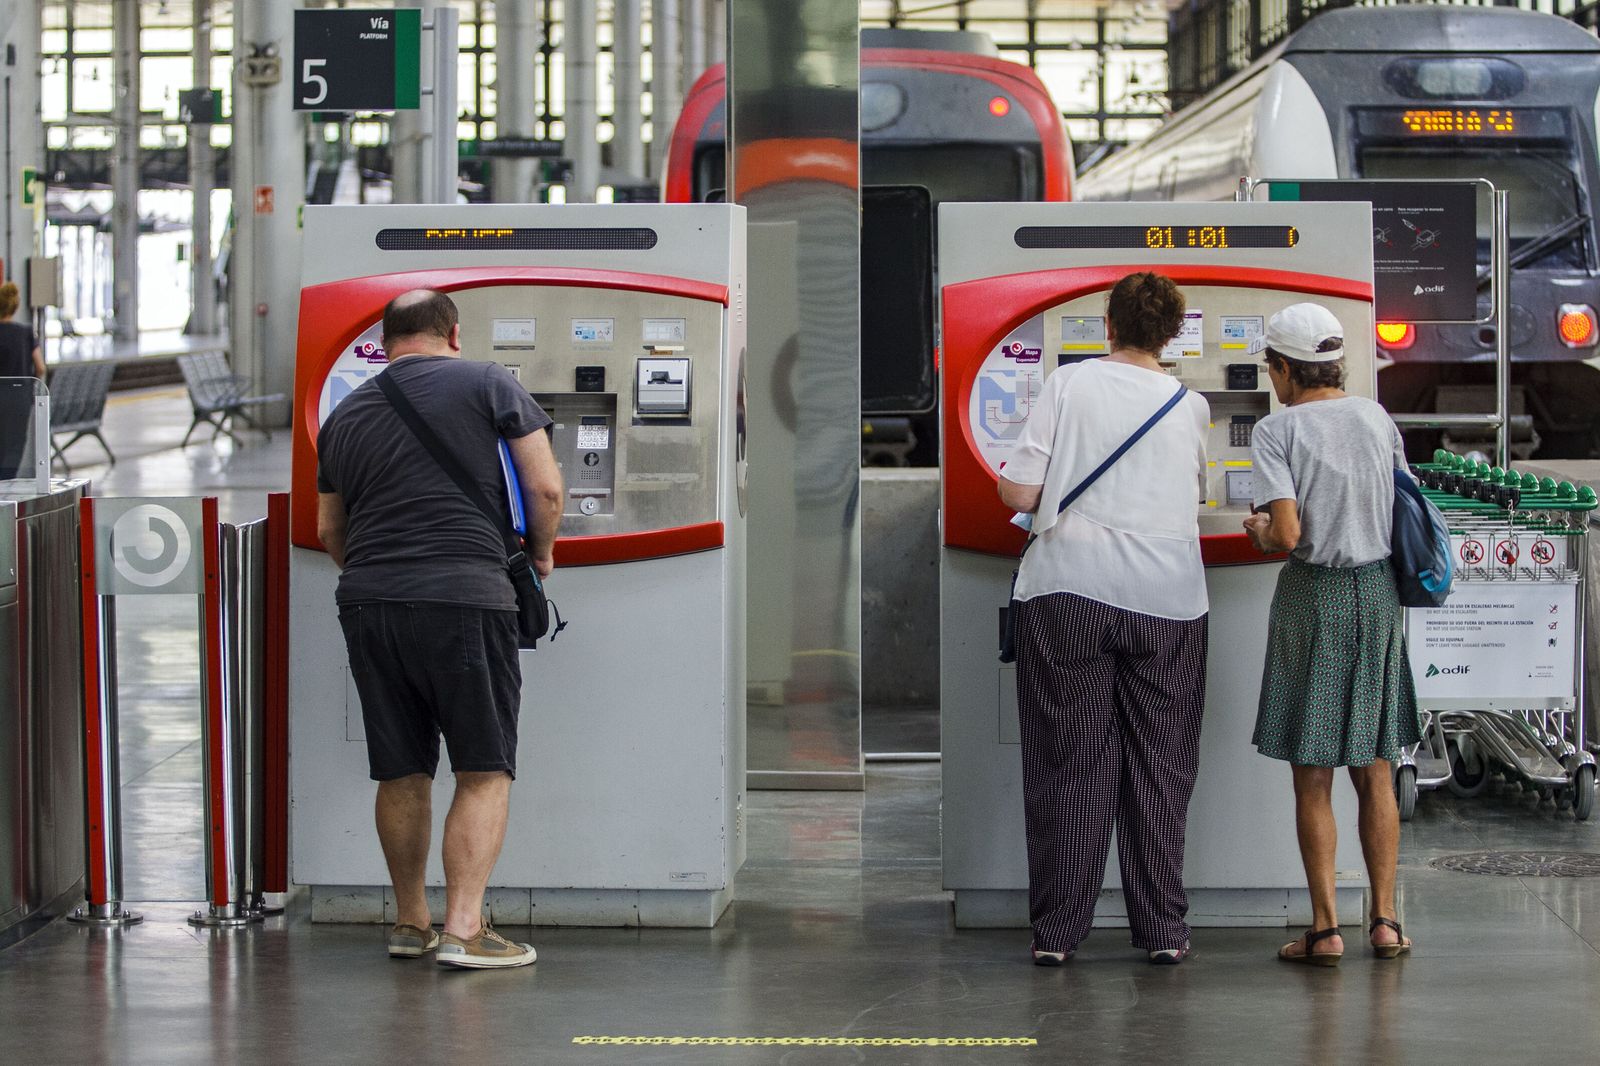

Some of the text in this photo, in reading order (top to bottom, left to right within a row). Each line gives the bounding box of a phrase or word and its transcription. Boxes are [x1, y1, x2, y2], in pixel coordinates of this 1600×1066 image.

[370, 17, 389, 30] Vía
[302, 58, 328, 105] 5
[1146, 226, 1174, 248] 01
[1441, 665, 1471, 674] adif
